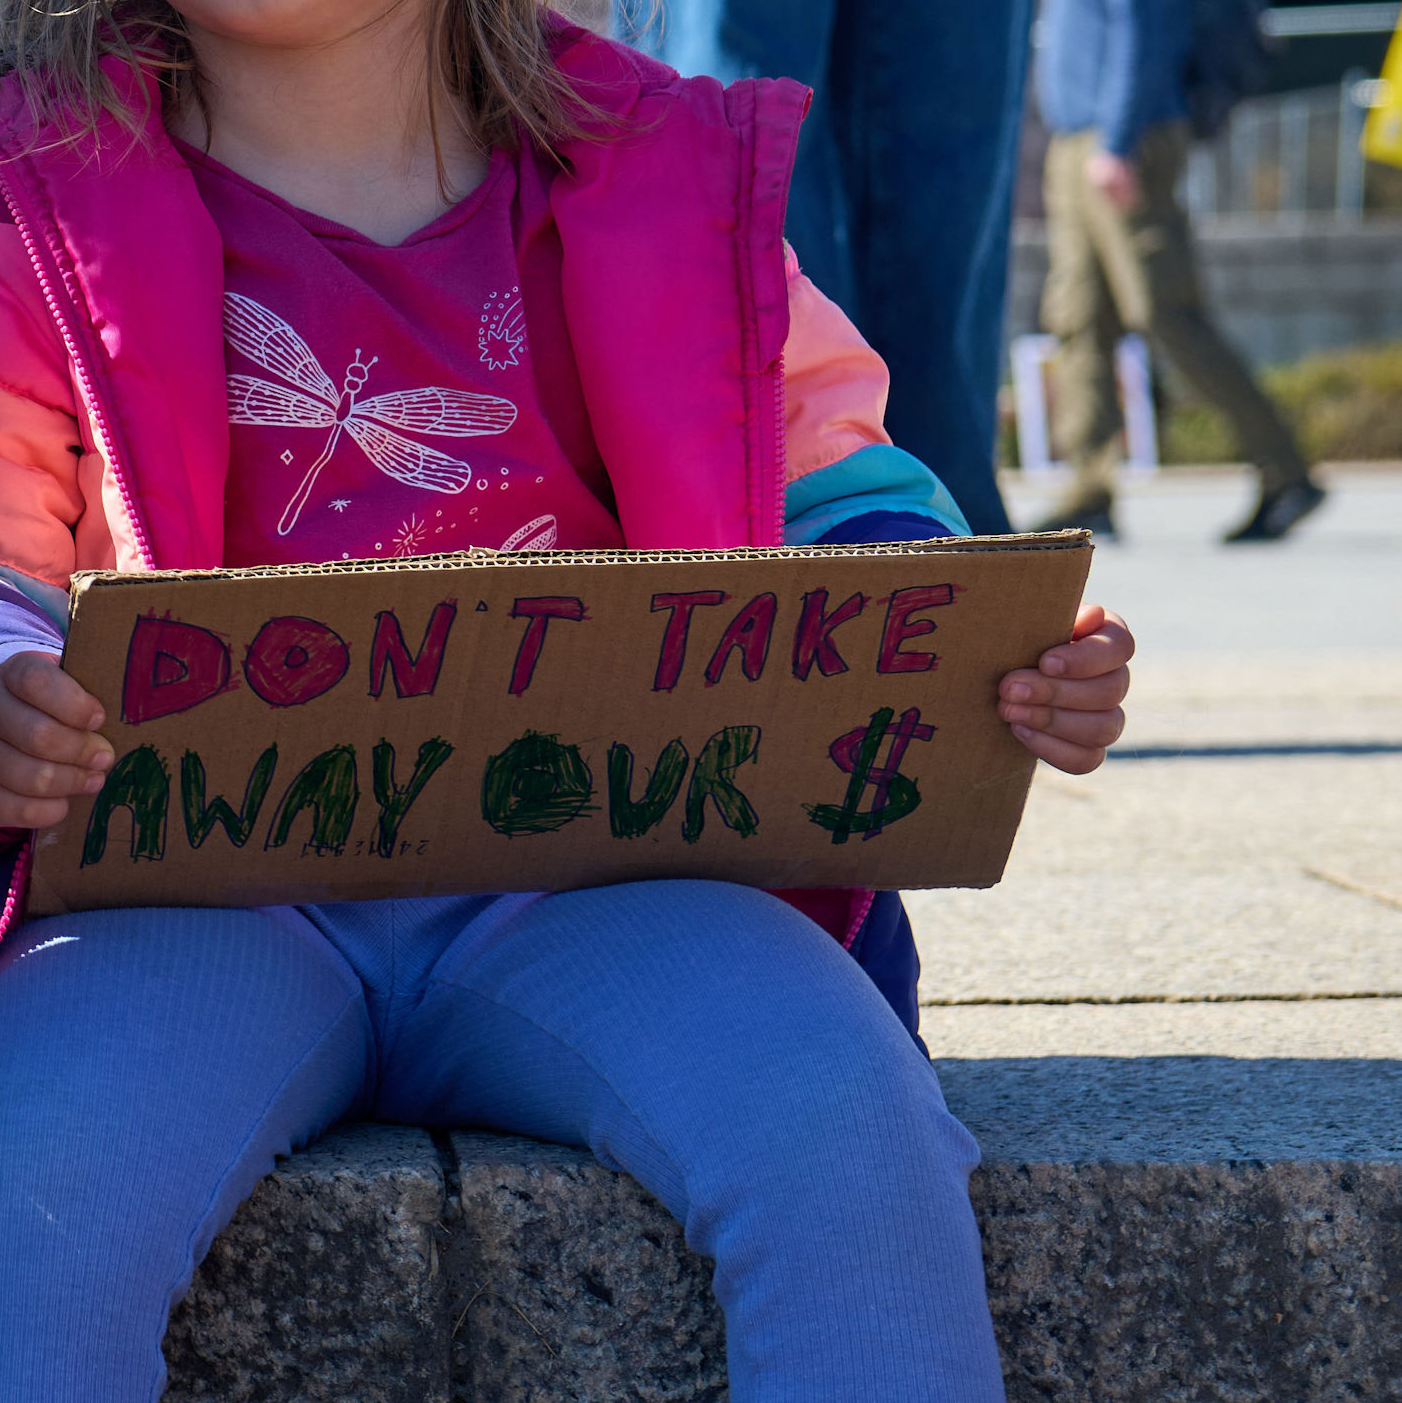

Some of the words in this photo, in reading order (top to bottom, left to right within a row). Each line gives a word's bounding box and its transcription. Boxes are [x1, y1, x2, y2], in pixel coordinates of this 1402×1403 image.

[120, 596, 591, 726] DON'T
[649, 583, 965, 695] TAKE
[80, 735, 457, 869] AWAY
[480, 728, 764, 845] OUR
[801, 706, 938, 846] $
